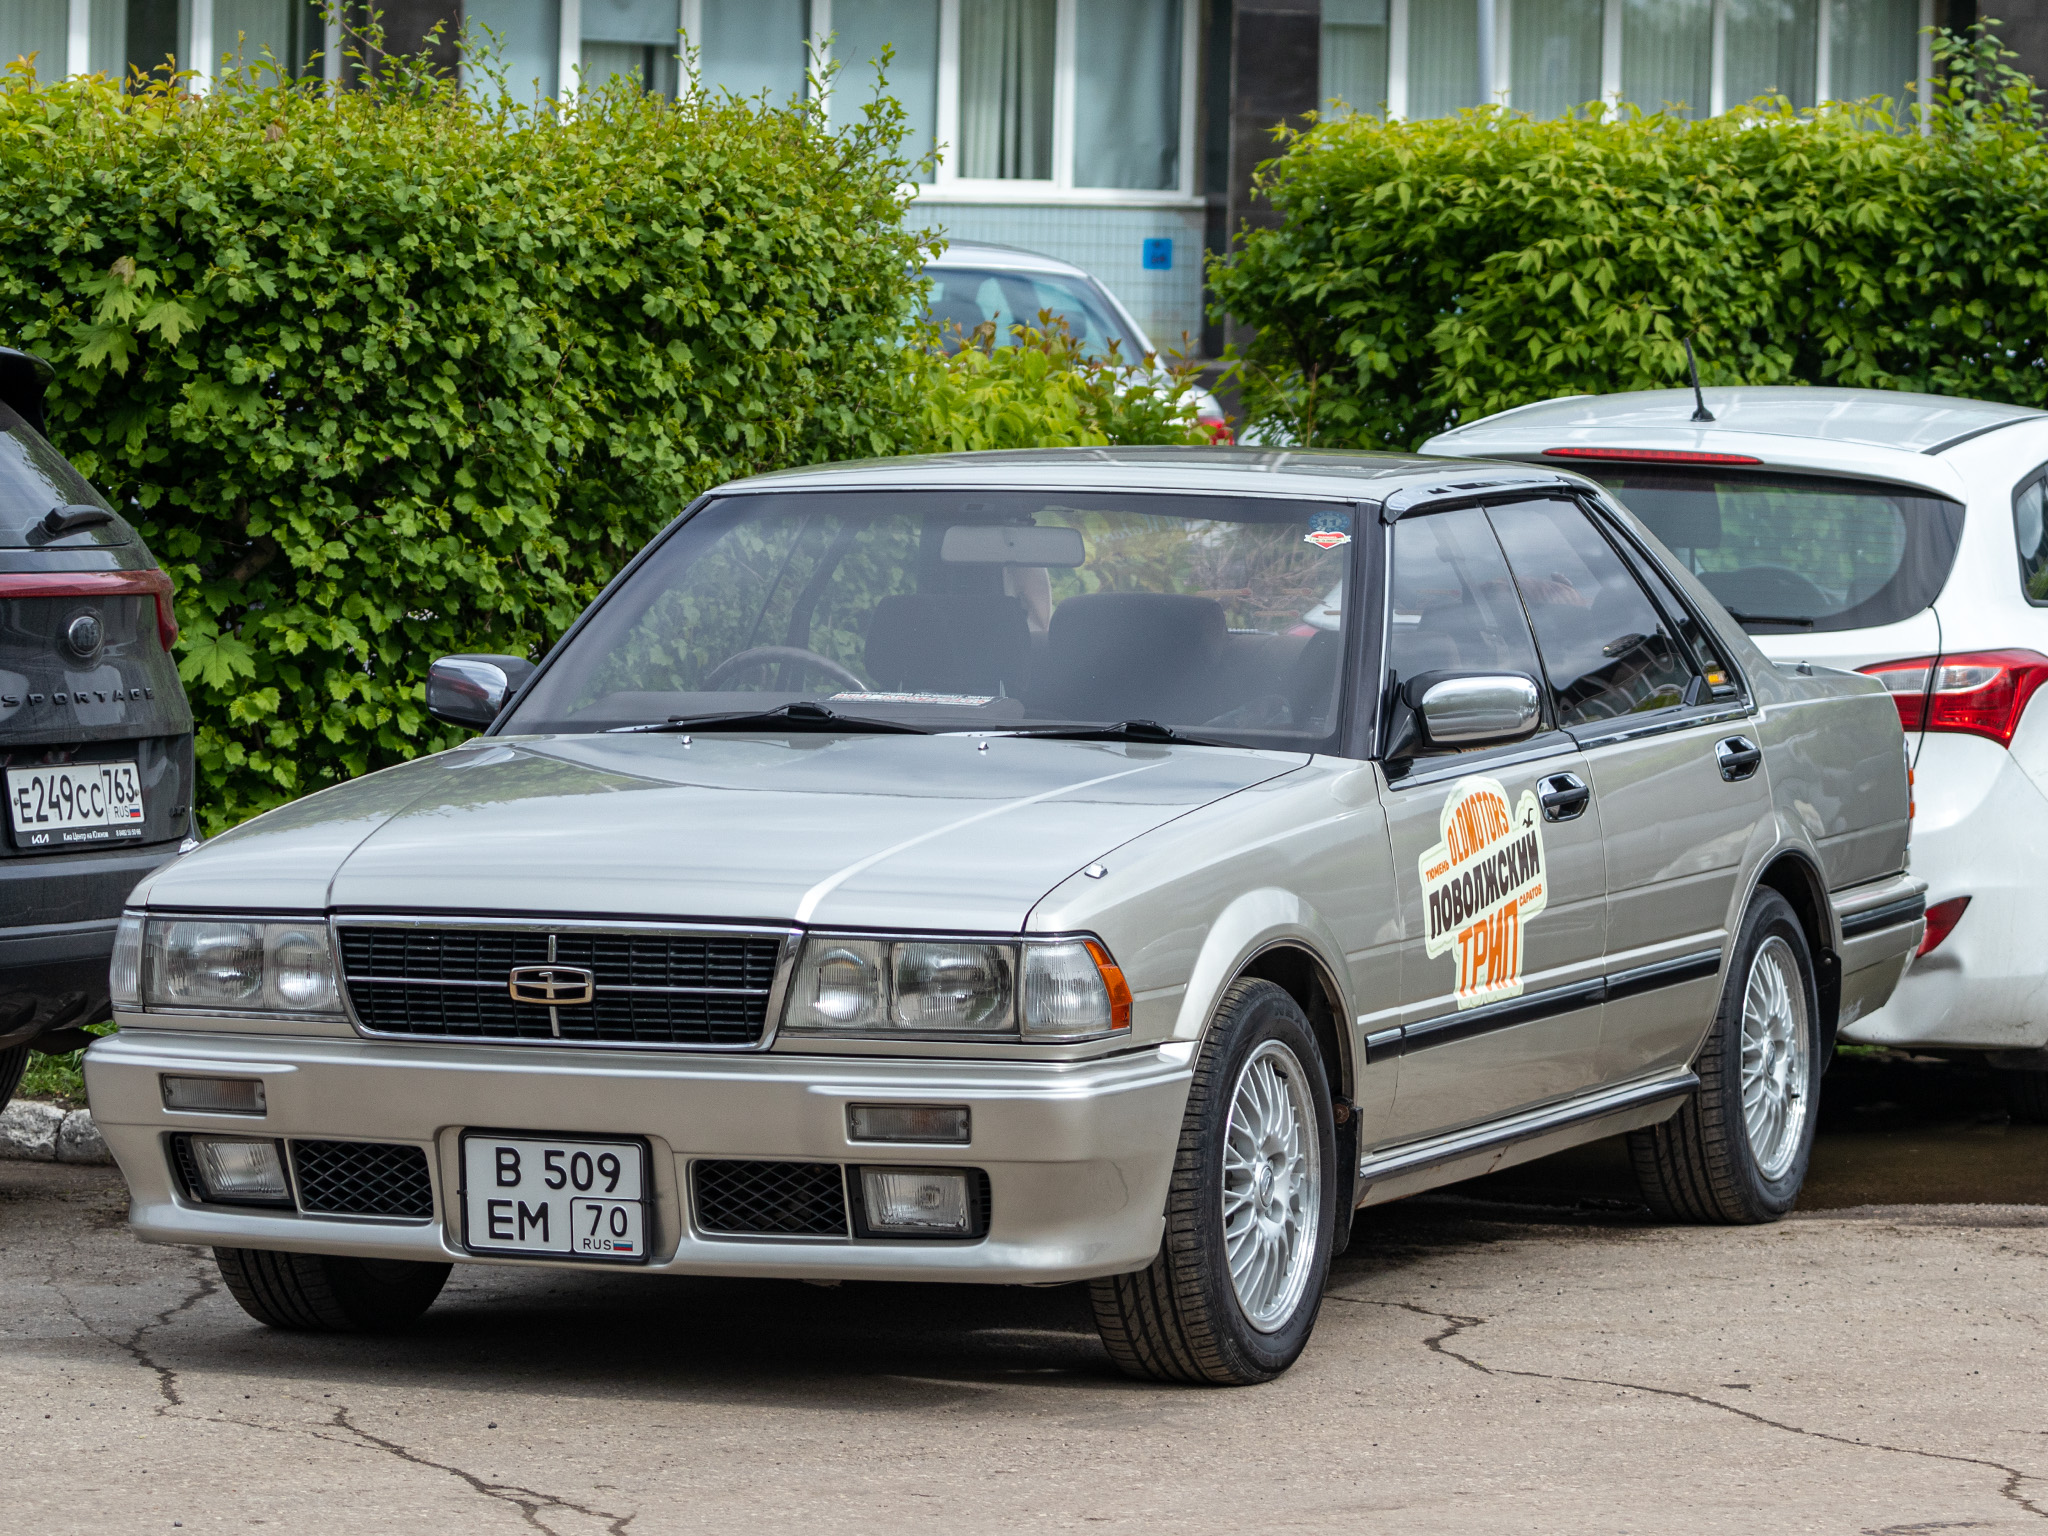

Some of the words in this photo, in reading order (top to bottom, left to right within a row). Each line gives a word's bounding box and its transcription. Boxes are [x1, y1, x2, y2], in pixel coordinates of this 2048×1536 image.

[2, 687, 155, 708] SPORTAGE
[18, 774, 104, 824] Е249СС
[103, 768, 135, 805] 763
[114, 805, 130, 818] RUS
[1447, 791, 1510, 867] OLDMOTORS
[1425, 859, 1449, 883] ТЮМЕНЬ
[1519, 883, 1543, 907] САРАТОВ
[1457, 898, 1518, 998] ТРИП
[496, 1147, 521, 1187] В
[544, 1149, 621, 1192] 509
[487, 1199, 550, 1242] ЕМ
[585, 1204, 628, 1237] 70
[583, 1238, 612, 1251] RUS
